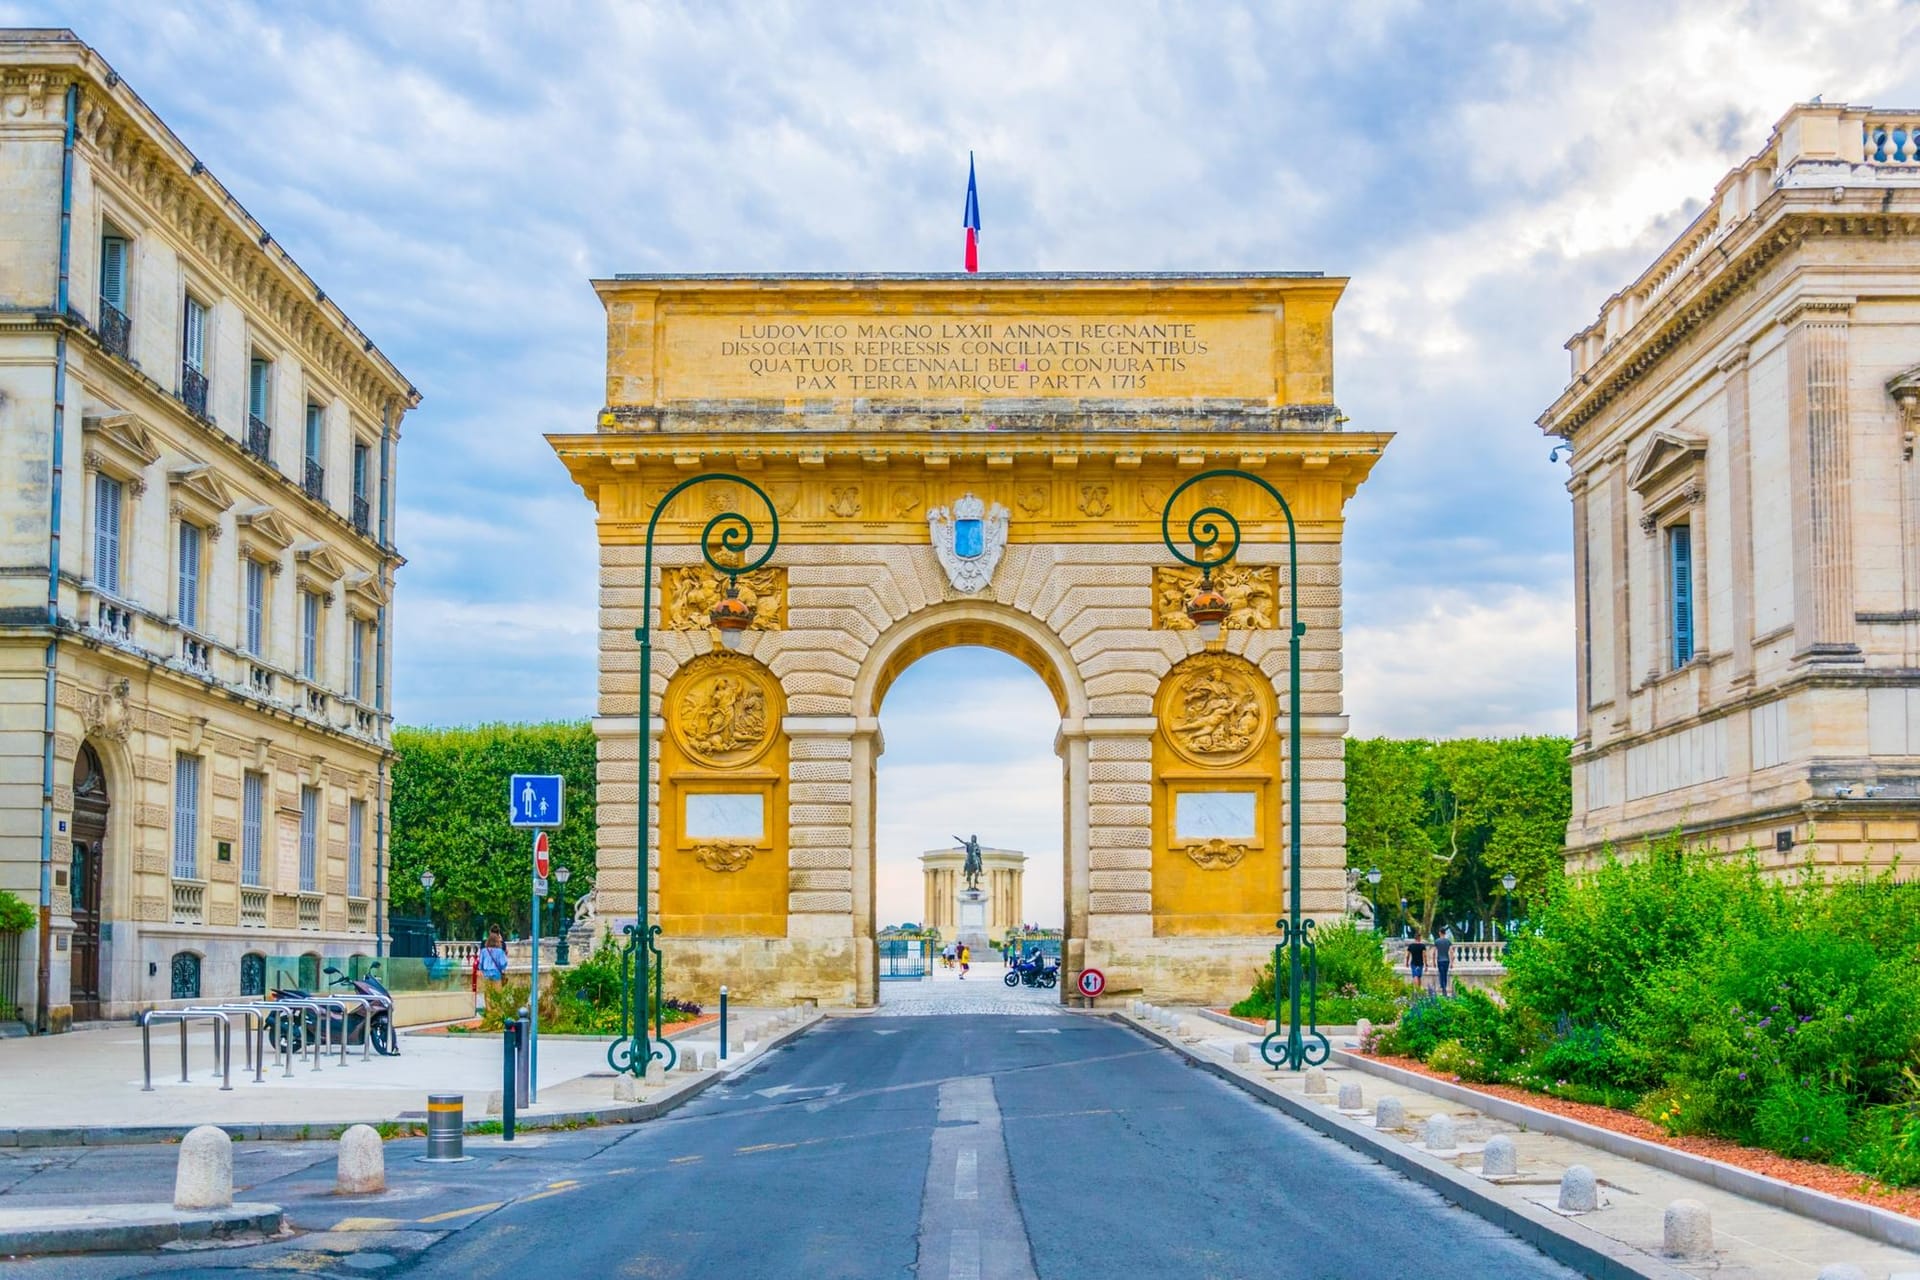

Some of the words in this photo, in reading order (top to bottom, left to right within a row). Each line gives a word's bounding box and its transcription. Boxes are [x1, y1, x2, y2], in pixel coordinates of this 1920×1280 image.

[739, 324, 848, 340] LUDOVICO
[857, 324, 932, 340] MAGNO
[942, 324, 992, 339] LXXII
[1003, 324, 1072, 339] ANNOS
[1081, 324, 1196, 339] REGNANTE
[722, 341, 845, 356] DISSOCIATIS
[854, 341, 951, 356] REPRESSIS
[961, 341, 1090, 356] CONCILIATIS
[1101, 341, 1208, 356] GENTIBUS
[749, 358, 853, 377] QUATUOR
[864, 358, 979, 373] DECENNALI
[988, 358, 1051, 373] BELLO
[1061, 358, 1186, 373] CONJURATIS
[796, 375, 837, 390] PAX
[848, 375, 918, 390] TERRA
[927, 375, 1019, 393] MARIQUE
[1030, 375, 1101, 390] PARTA
